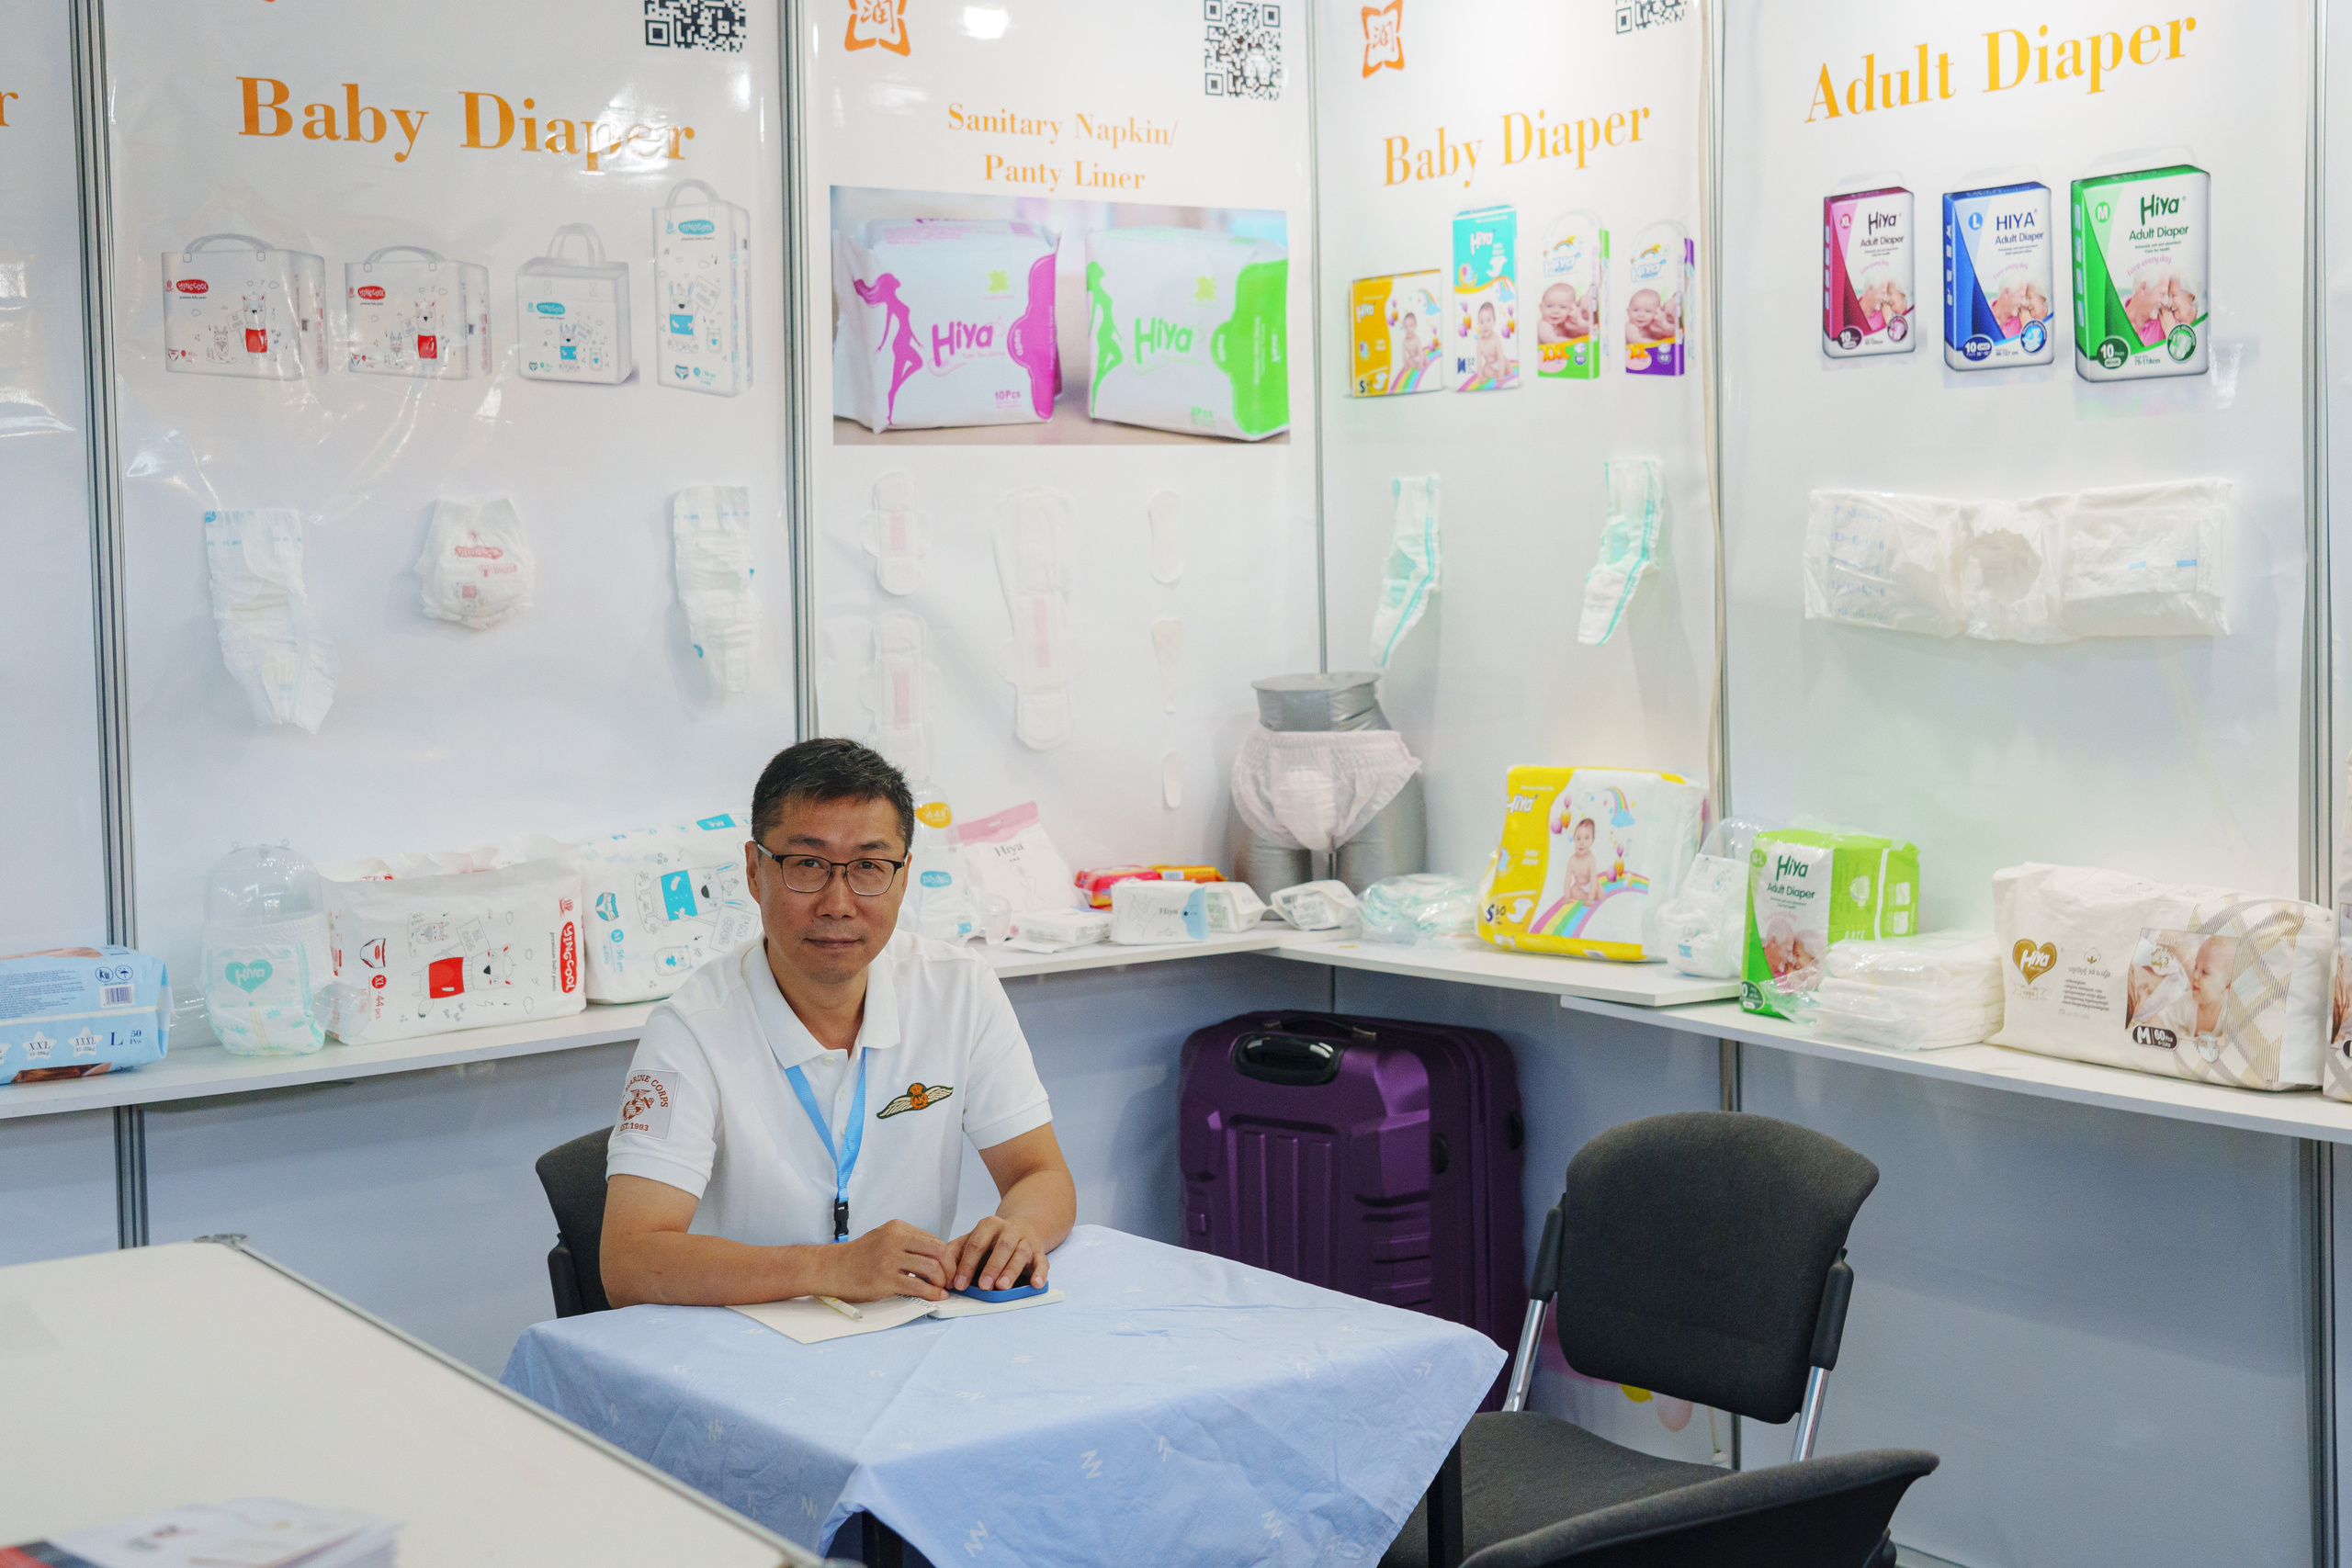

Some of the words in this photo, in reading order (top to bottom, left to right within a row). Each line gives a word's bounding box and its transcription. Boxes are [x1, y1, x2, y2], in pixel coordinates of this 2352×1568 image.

[1804, 42, 1957, 123] Adult
[1982, 16, 2197, 95] Diaper
[236, 76, 429, 163] Baby
[458, 90, 695, 172] Diaper
[948, 103, 1063, 144] Sanitary
[1074, 113, 1178, 149] Napkin/
[1383, 127, 1483, 187] Baby
[1500, 107, 1650, 171] Diaper
[984, 154, 1063, 192] Panty
[1074, 160, 1147, 191] Liner
[2097, 205, 2109, 220] M
[2140, 194, 2179, 226] Hiya
[1868, 211, 1896, 235] Hiya
[1972, 214, 1981, 229] L
[1996, 212, 2035, 231] HIYA
[1860, 238, 1878, 247] Adult
[1880, 235, 1905, 246] Diaper
[1995, 234, 2018, 245] Adult
[2019, 231, 2044, 243] Diaper
[2129, 230, 2154, 241] Adult
[2157, 225, 2189, 240] Diaper
[932, 321, 993, 367] Hiya
[1135, 317, 1193, 365] Hiya
[1964, 342, 1977, 353] 10
[2100, 344, 2114, 358] 10
[994, 841, 1025, 858] Hiya
[1776, 855, 1809, 881] Hiya
[1767, 883, 1785, 895] Adult
[1786, 886, 1815, 899] Diaper
[562, 924, 575, 991] YINGCOOL
[2019, 949, 2051, 972] Hiya
[235, 967, 266, 987] Hiya
[374, 976, 384, 987] XL
[109, 1032, 124, 1046] L
[2137, 1026, 2152, 1044] M
[2154, 1029, 2165, 1041] 60
[29, 1041, 51, 1051] XXL
[651, 1079, 669, 1108] CORPS
